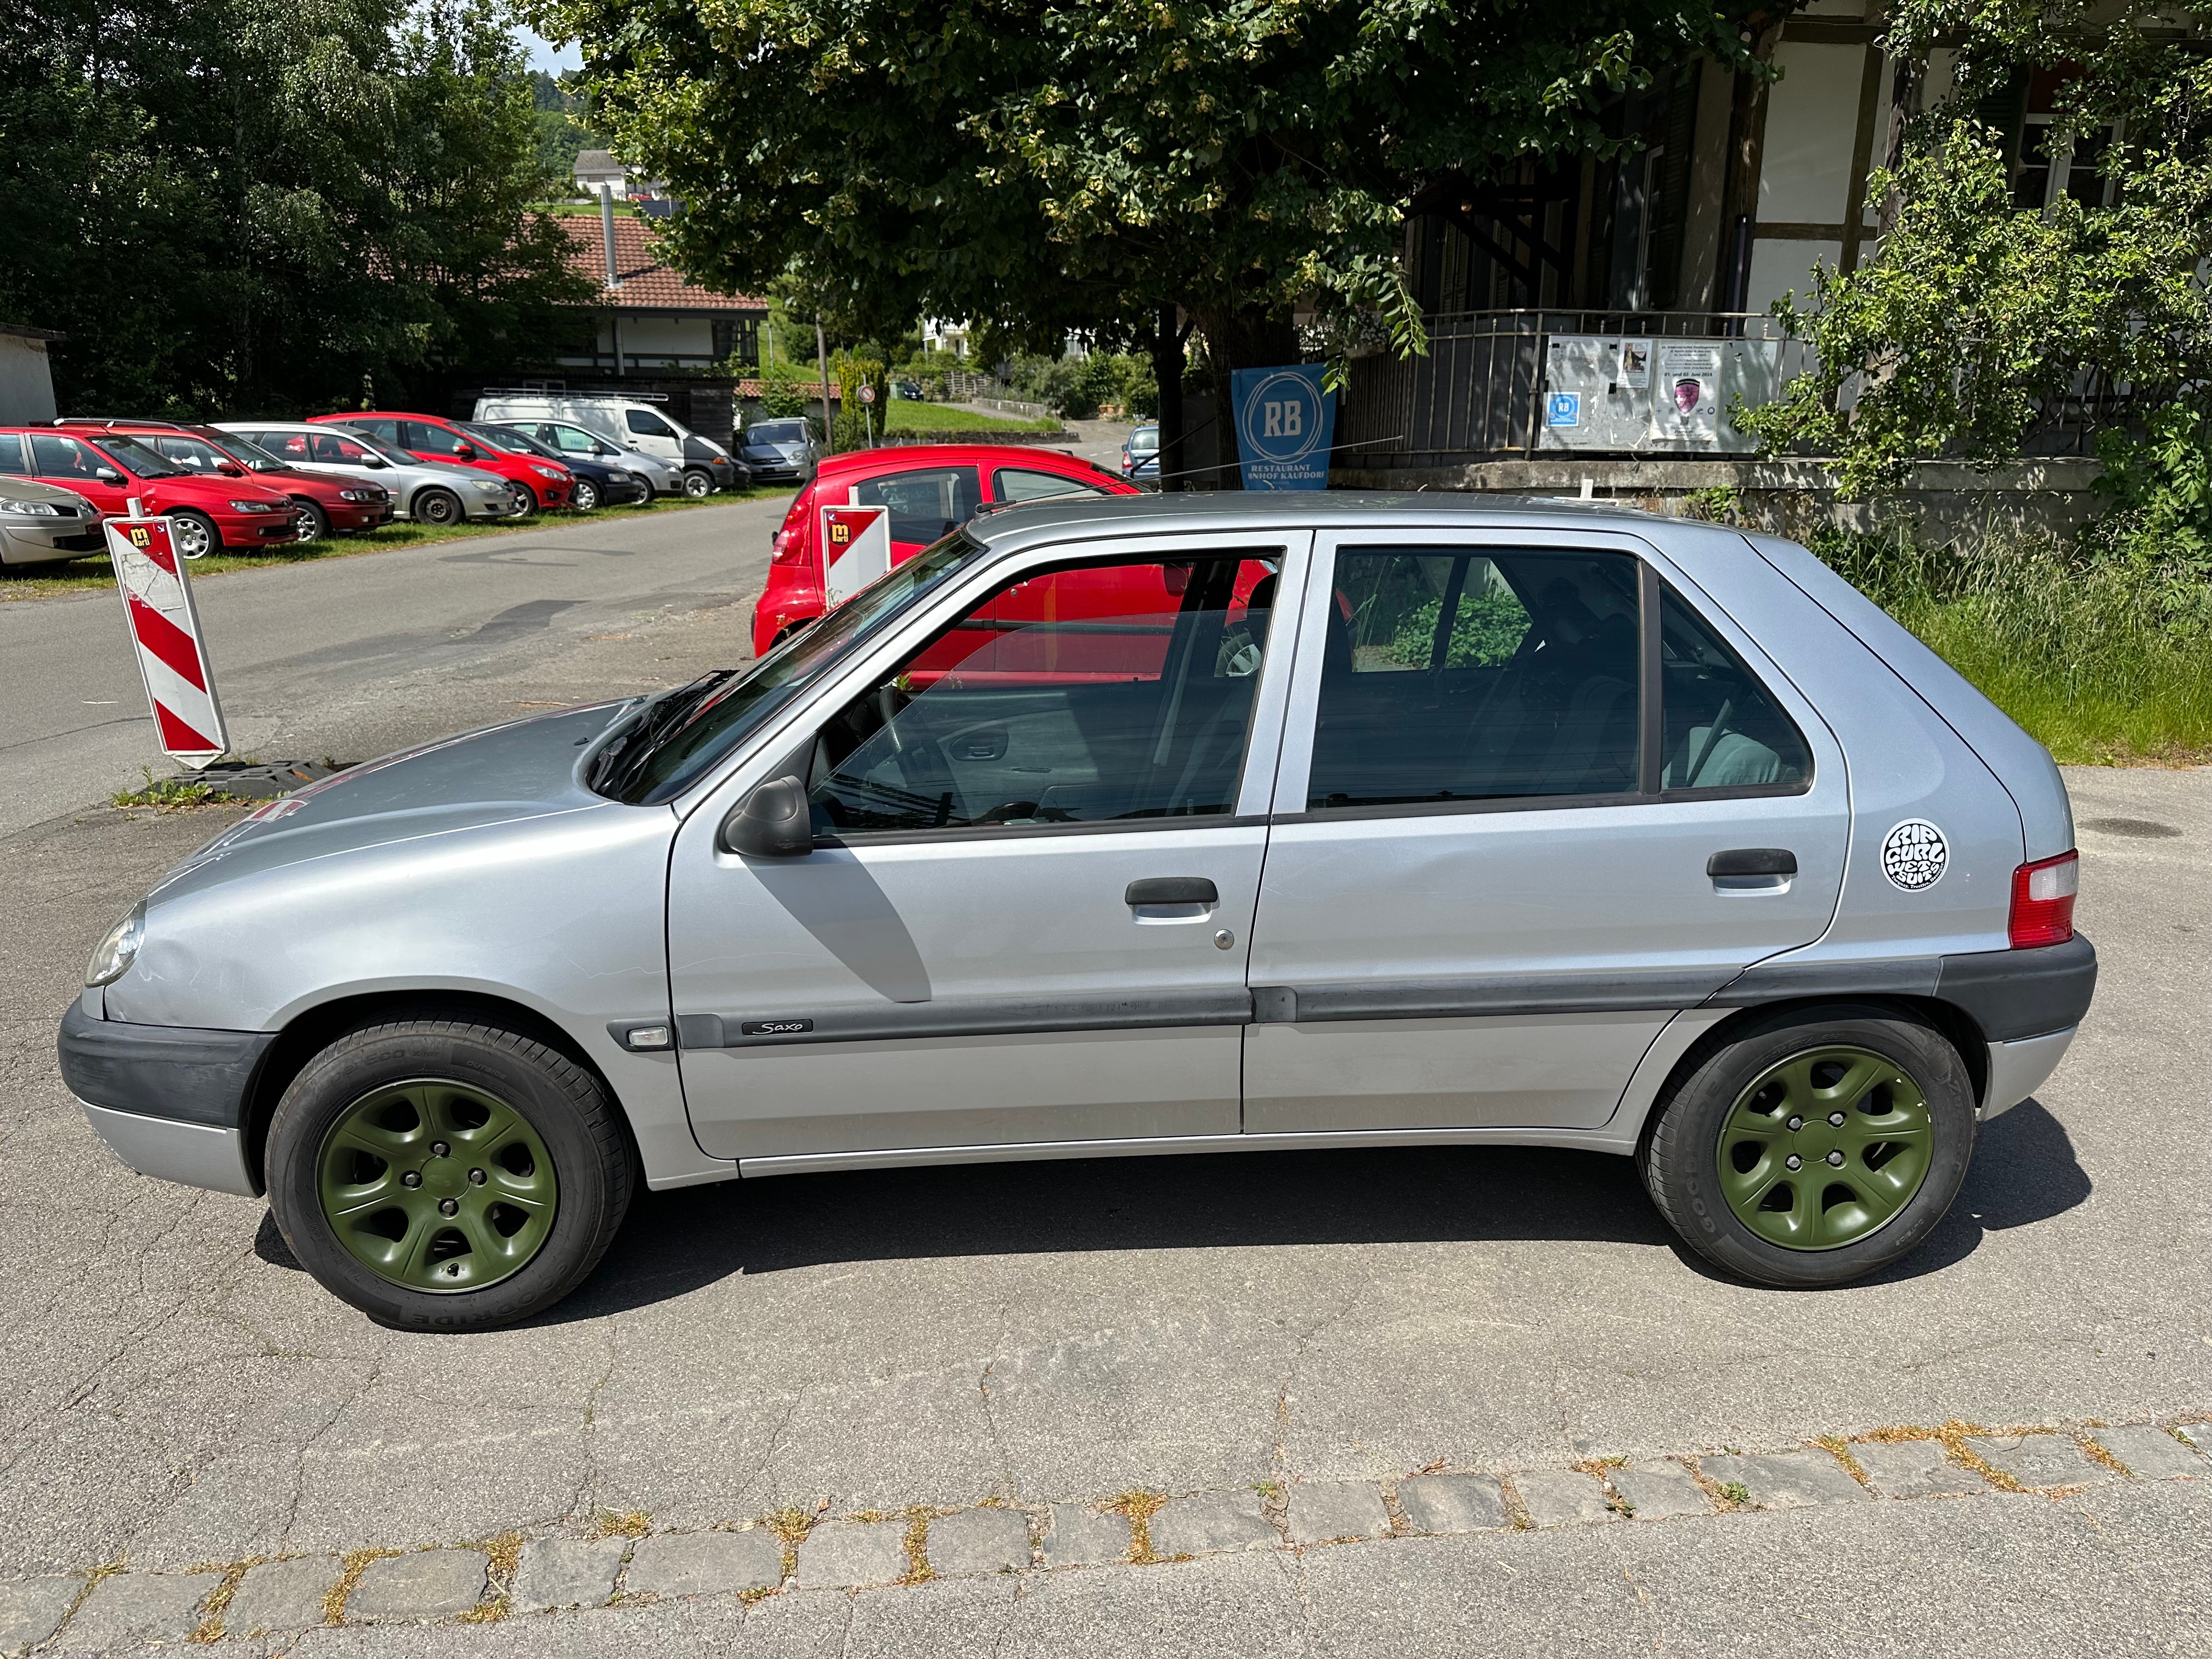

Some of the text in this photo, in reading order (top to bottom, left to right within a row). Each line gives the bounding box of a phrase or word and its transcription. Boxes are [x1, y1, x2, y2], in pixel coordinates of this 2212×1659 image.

[1558, 402, 1569, 412] RB
[1263, 400, 1301, 437] RB
[1251, 464, 1311, 472] RESTAURANT
[1280, 471, 1325, 479] KAUFDORF
[1888, 824, 1938, 848] RIP
[1886, 842, 1945, 864] CURL
[752, 1023, 803, 1035] Saxo
[466, 1060, 507, 1080] OUTSIDE
[412, 1259, 571, 1326] GOODRIDE
